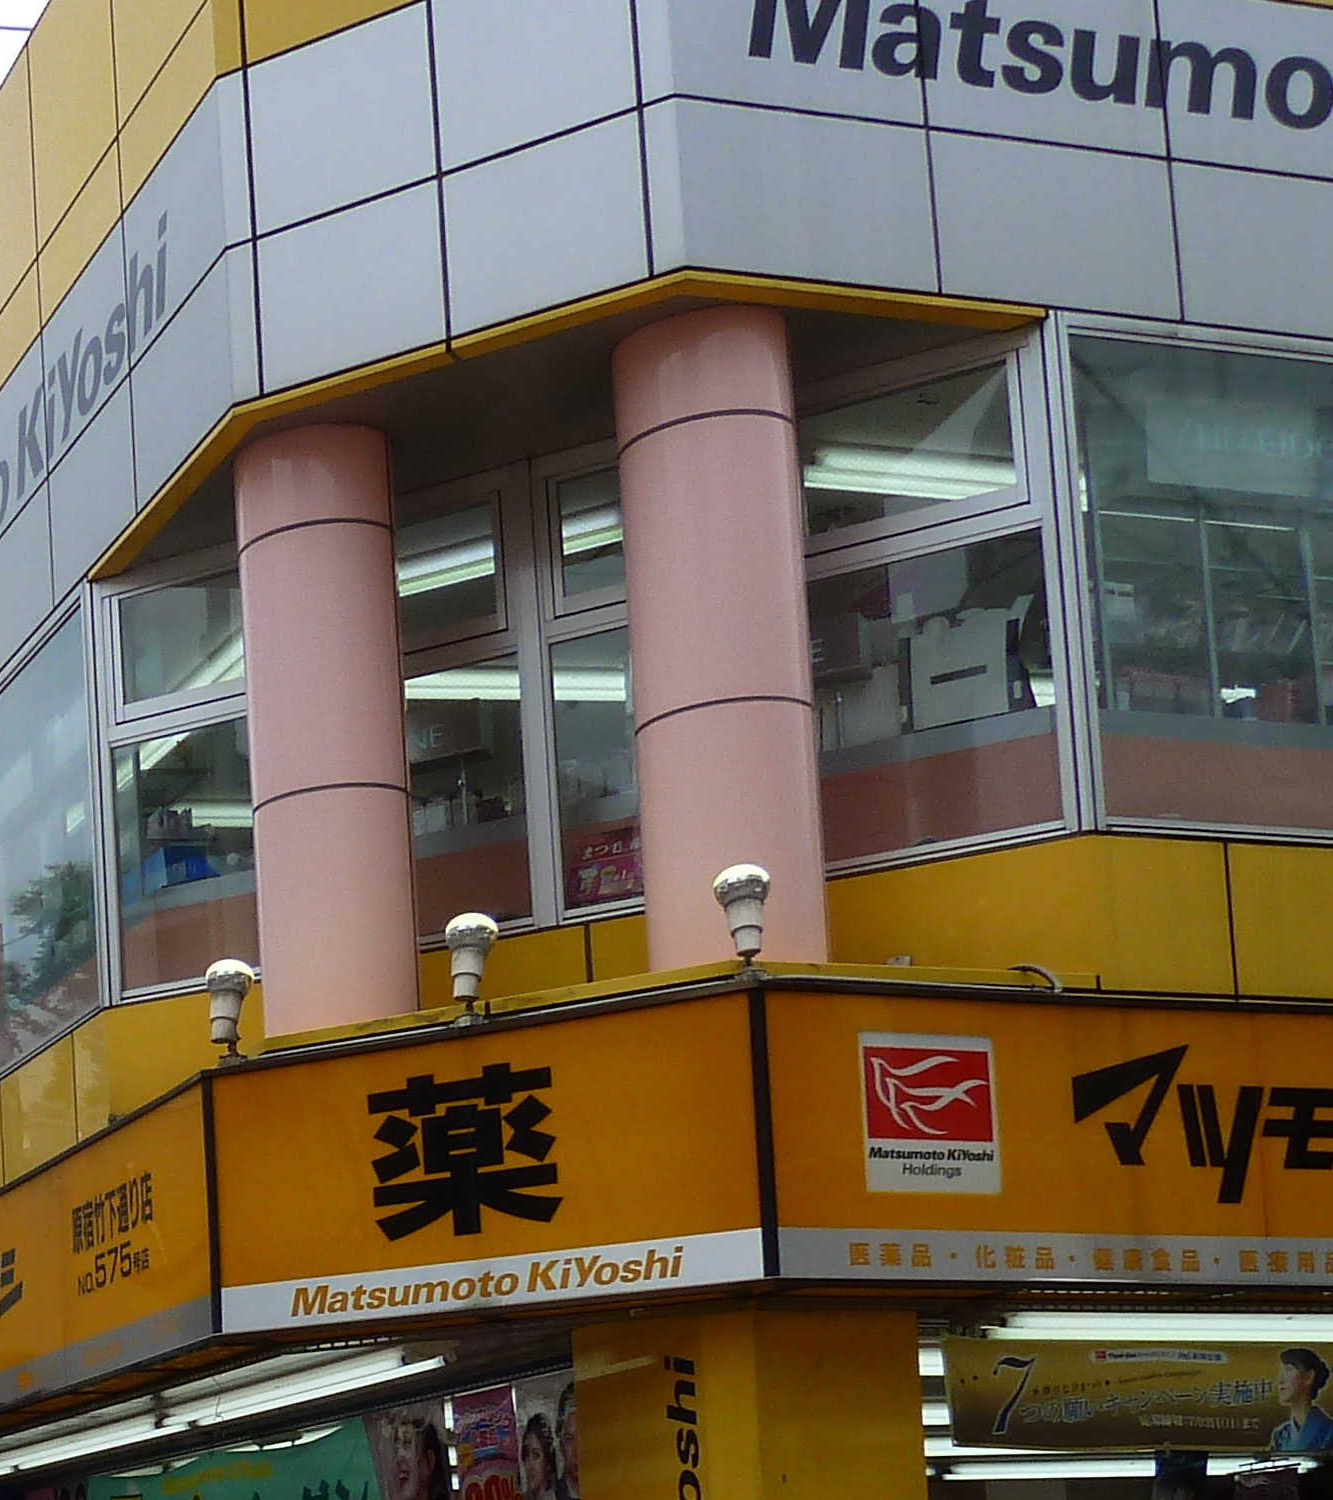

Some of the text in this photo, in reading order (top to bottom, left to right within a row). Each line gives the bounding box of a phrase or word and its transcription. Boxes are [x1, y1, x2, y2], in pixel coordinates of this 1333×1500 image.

[16, 210, 170, 502] KiYoshi
[367, 1062, 564, 1242] 薬
[868, 1146, 995, 1164] Matsumoto KiYoshi
[901, 1163, 963, 1179] Holdings
[72, 1170, 154, 1254] 原宿竹下通り店
[290, 1246, 685, 1318] Matsumoto KiYoshi
